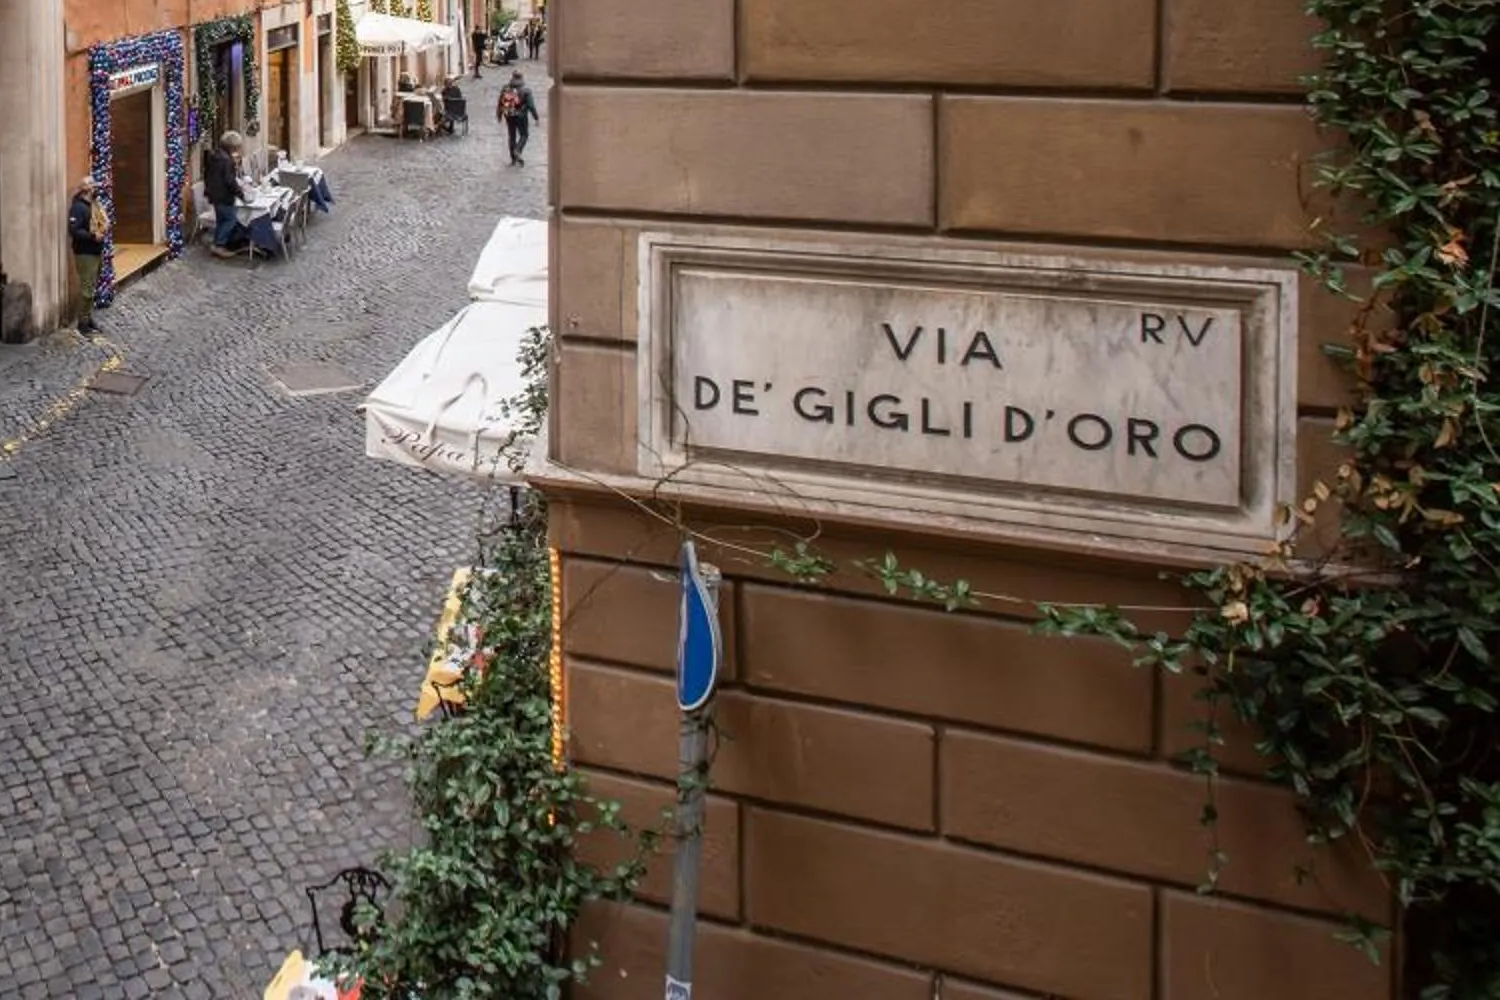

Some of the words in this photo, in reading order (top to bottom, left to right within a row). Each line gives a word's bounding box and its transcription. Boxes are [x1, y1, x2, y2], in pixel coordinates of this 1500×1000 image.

[880, 322, 1003, 370] VIA
[792, 386, 974, 440] GIGLI
[1003, 403, 1223, 464] D'ORO
